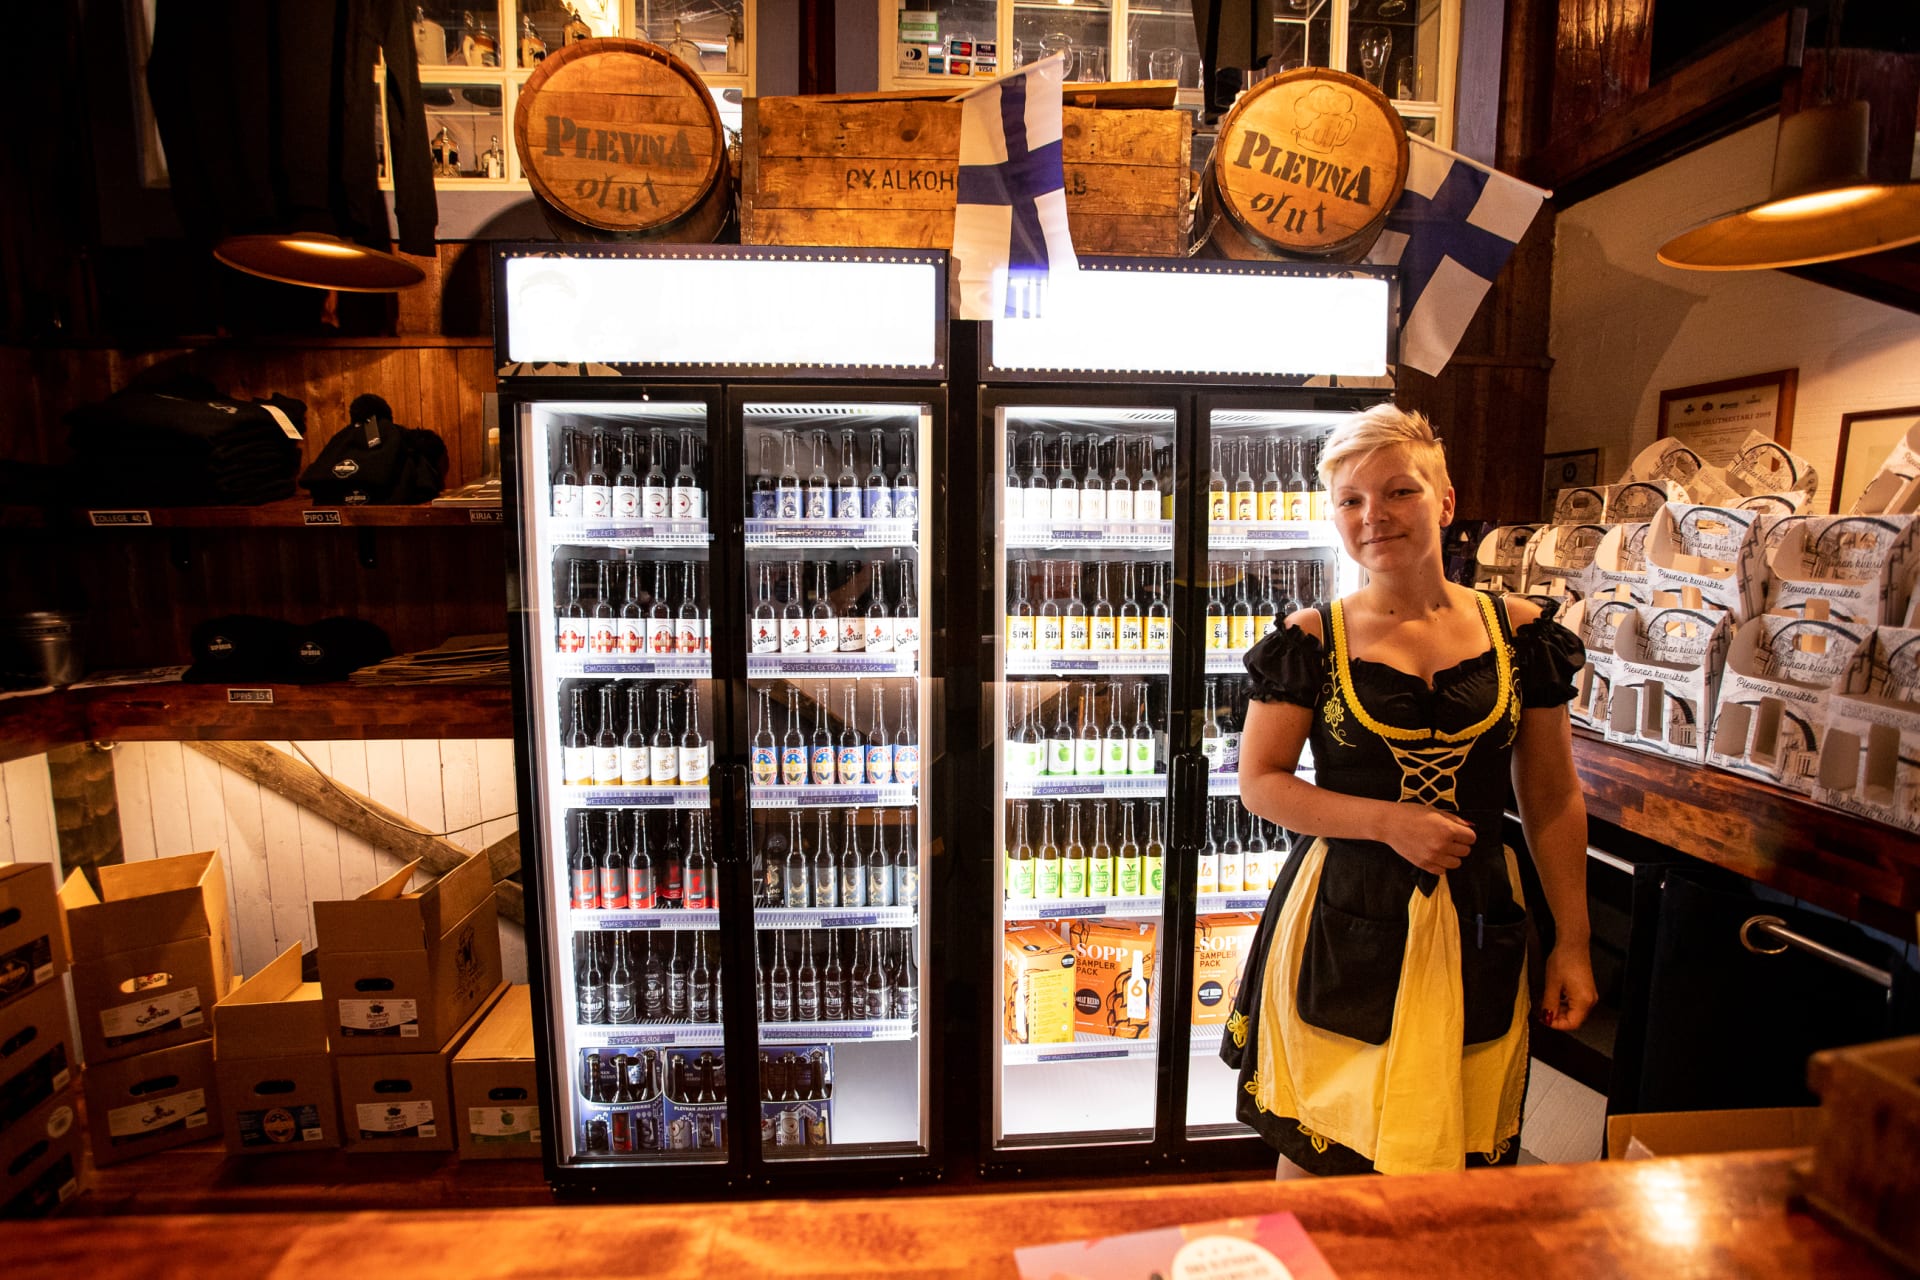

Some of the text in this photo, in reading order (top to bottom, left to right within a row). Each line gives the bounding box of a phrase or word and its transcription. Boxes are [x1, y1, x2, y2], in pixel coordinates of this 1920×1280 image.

[542, 115, 697, 173] PLEVNA
[1233, 130, 1371, 205] PLEVNA
[574, 172, 662, 213] olut
[1250, 192, 1327, 234] olut
[305, 514, 324, 522] PIPO
[471, 512, 492, 521] KIRJA
[1657, 568, 1725, 591] Plevnan kuusikko
[1781, 582, 1861, 600] Plevnan kuusikko
[1623, 662, 1690, 685] Plevnan kuusikko
[1736, 676, 1819, 706] Plevnan kuusikko
[1076, 943, 1129, 962] SOPP
[1199, 951, 1237, 961] SAMPLER
[1076, 959, 1116, 970] SAMPLER
[1076, 966, 1099, 976] PACK
[1199, 959, 1221, 968] PACK
[1131, 979, 1143, 998] 6
